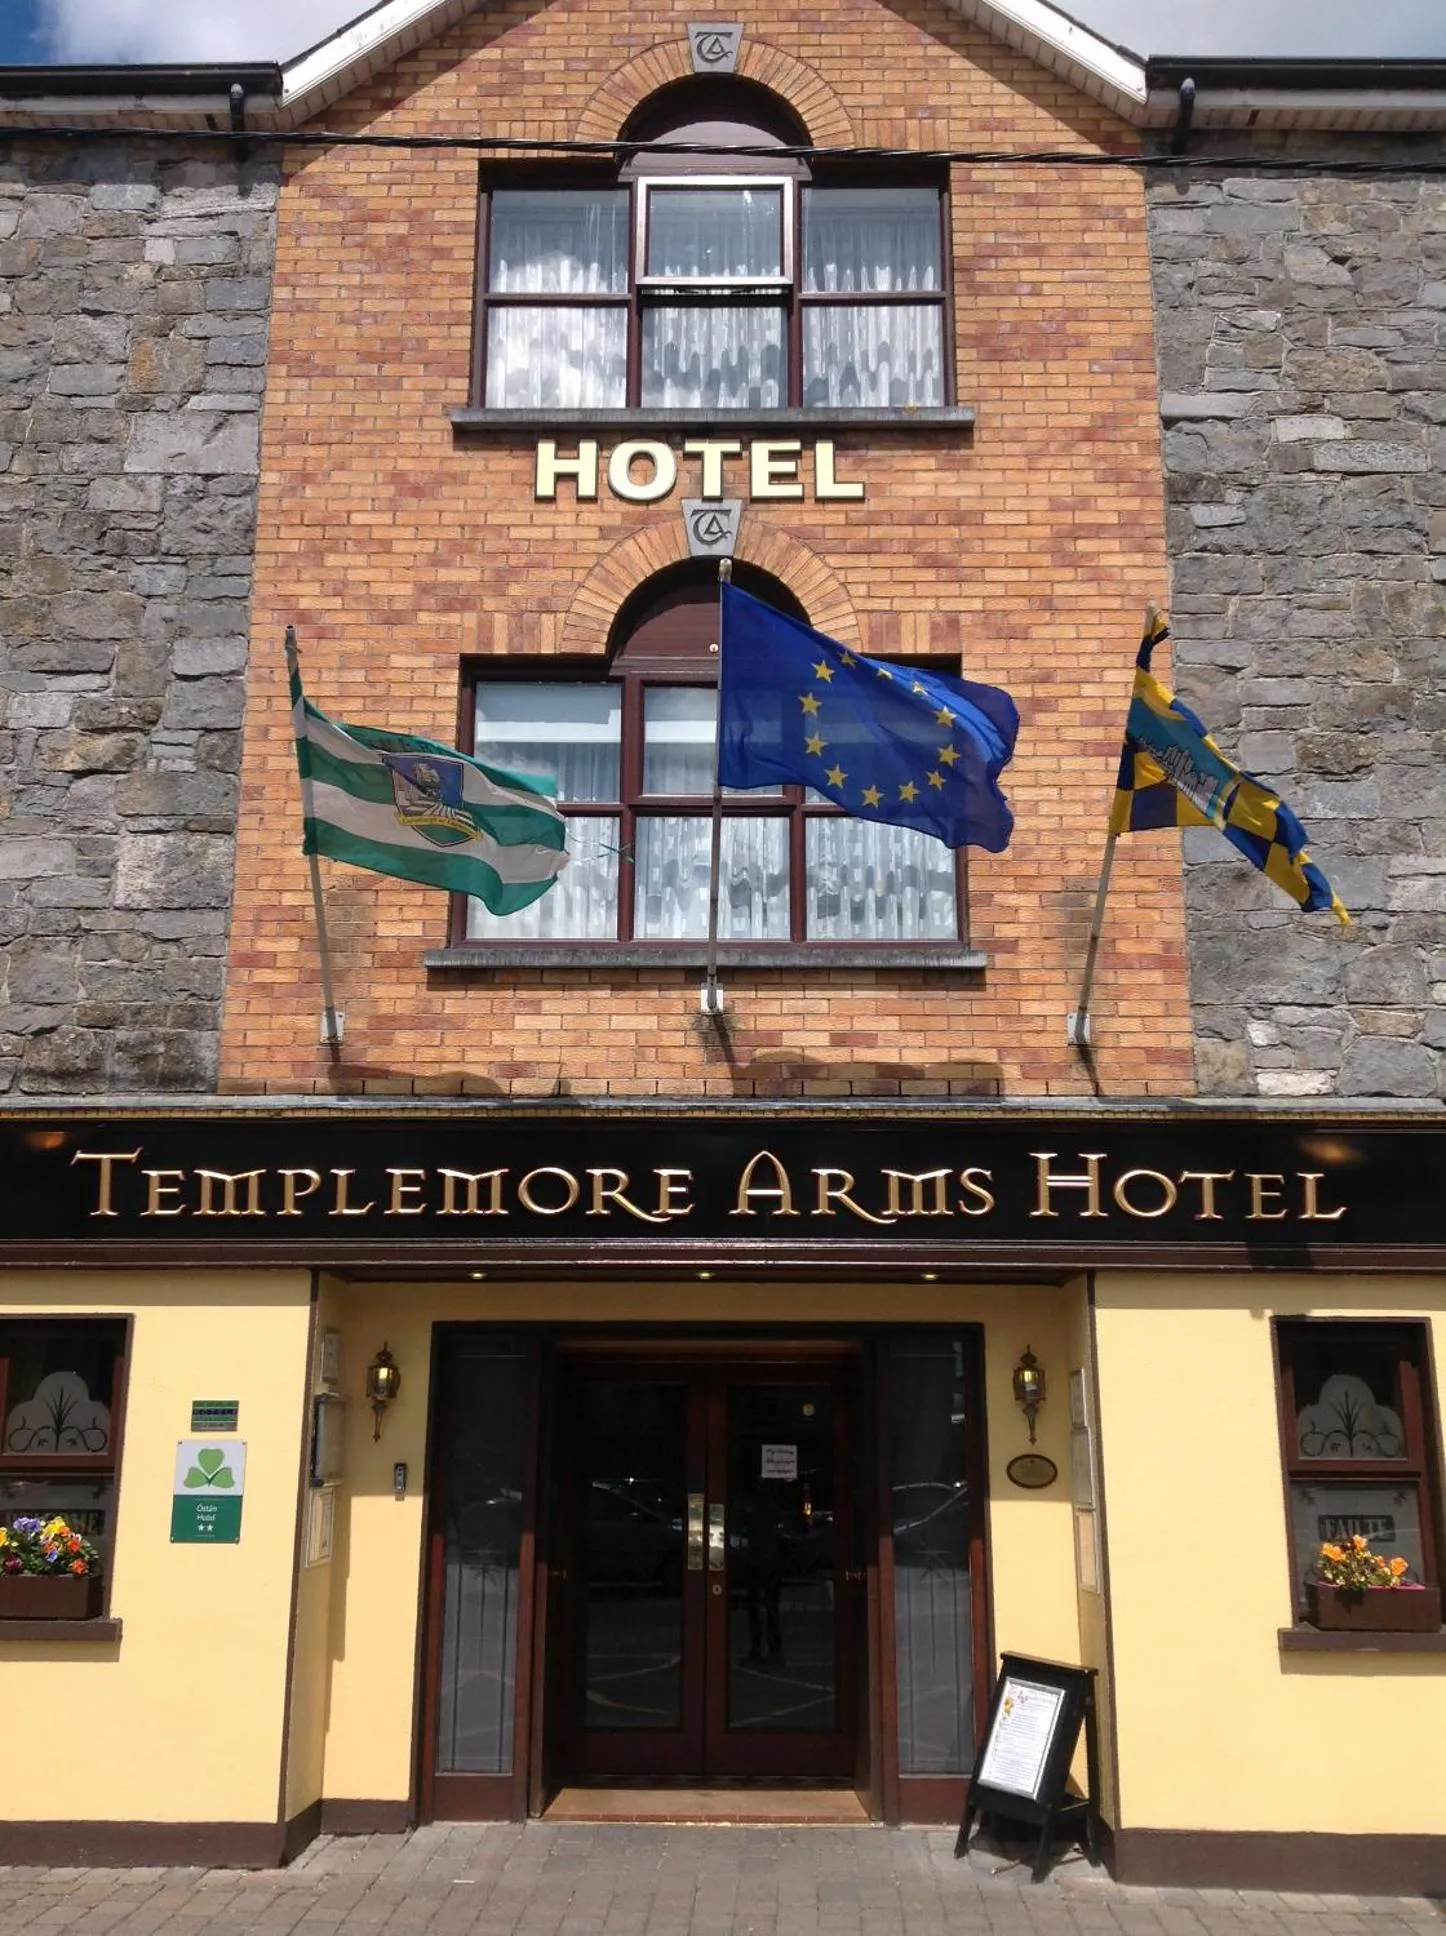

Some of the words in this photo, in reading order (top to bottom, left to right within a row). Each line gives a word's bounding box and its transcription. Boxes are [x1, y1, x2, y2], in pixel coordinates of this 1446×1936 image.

[535, 439, 865, 501] HOTEL
[69, 1146, 694, 1222] TEMPLEMORE
[728, 1150, 995, 1224] ARMS
[1029, 1151, 1347, 1220] HOTEL
